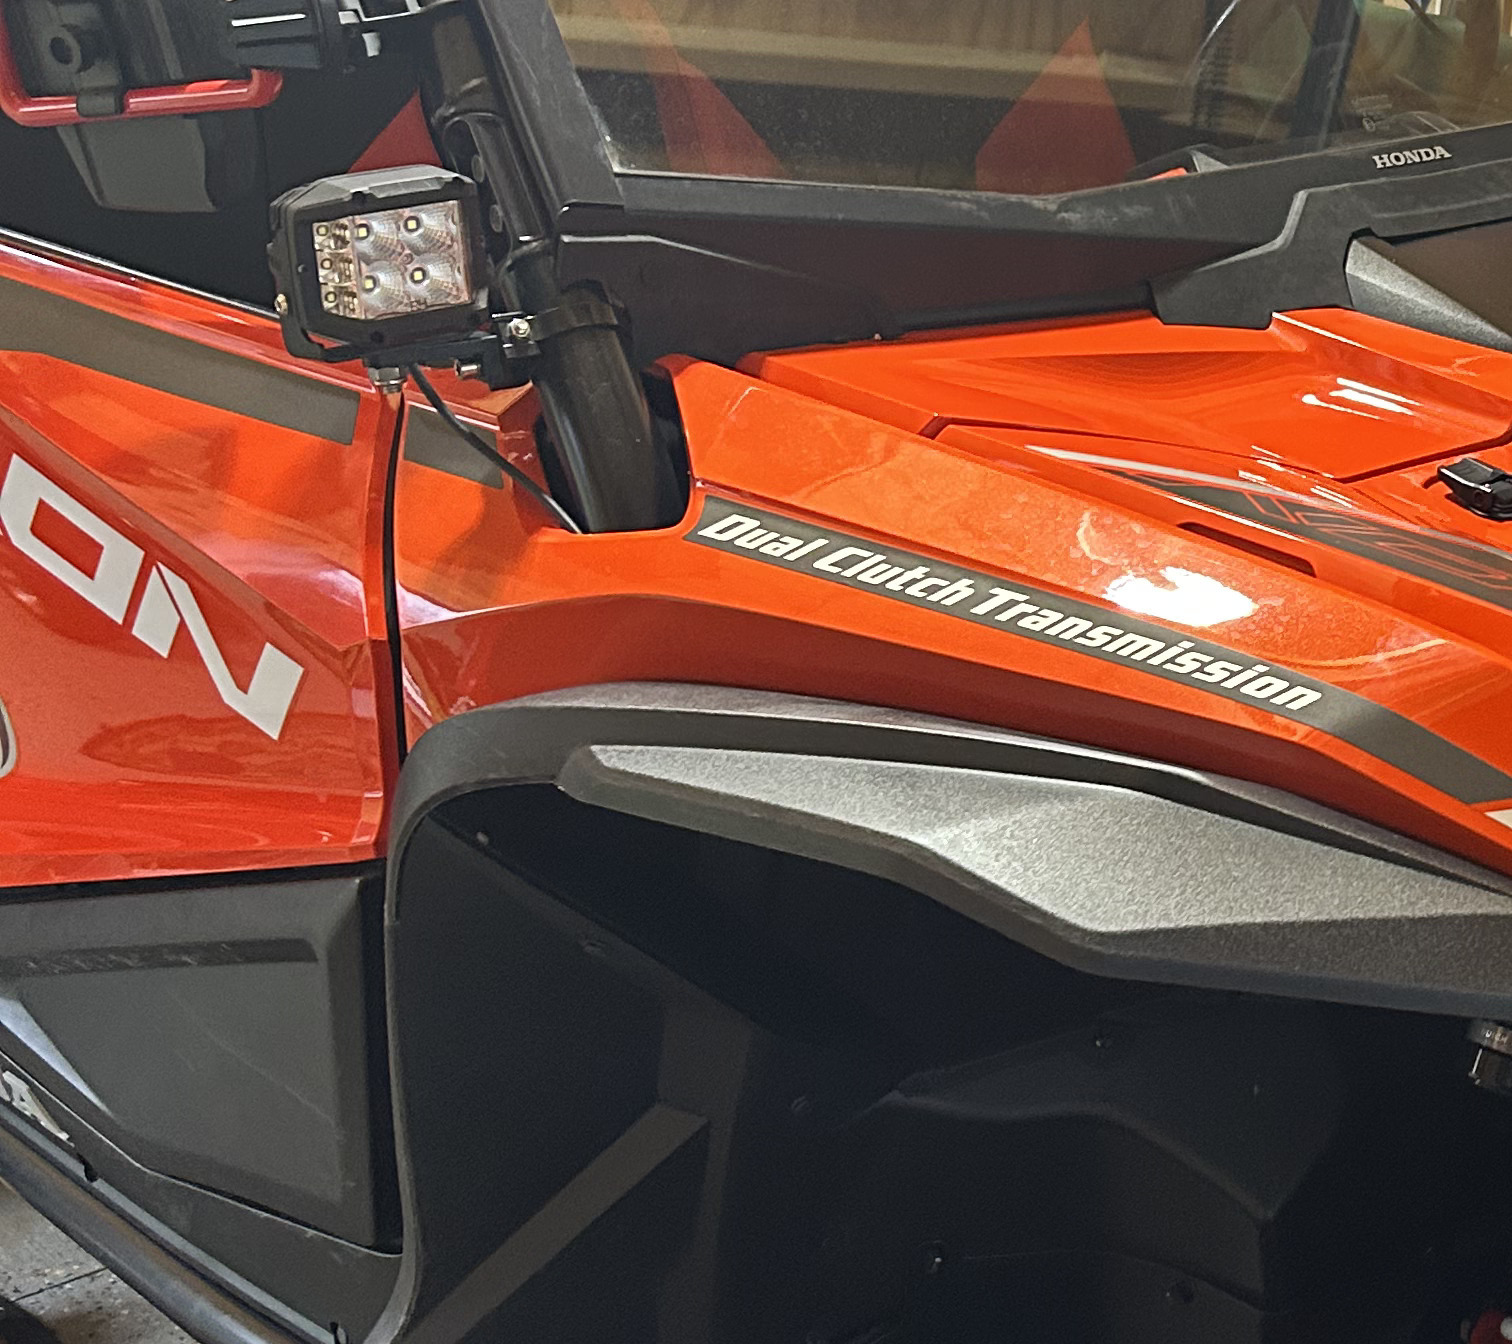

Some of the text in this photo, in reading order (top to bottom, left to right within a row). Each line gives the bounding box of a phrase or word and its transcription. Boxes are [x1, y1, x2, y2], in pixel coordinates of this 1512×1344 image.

[1371, 145, 1453, 169] HONDA
[0, 452, 304, 740] ON
[697, 513, 1323, 712] Dual Clutch Transmission
